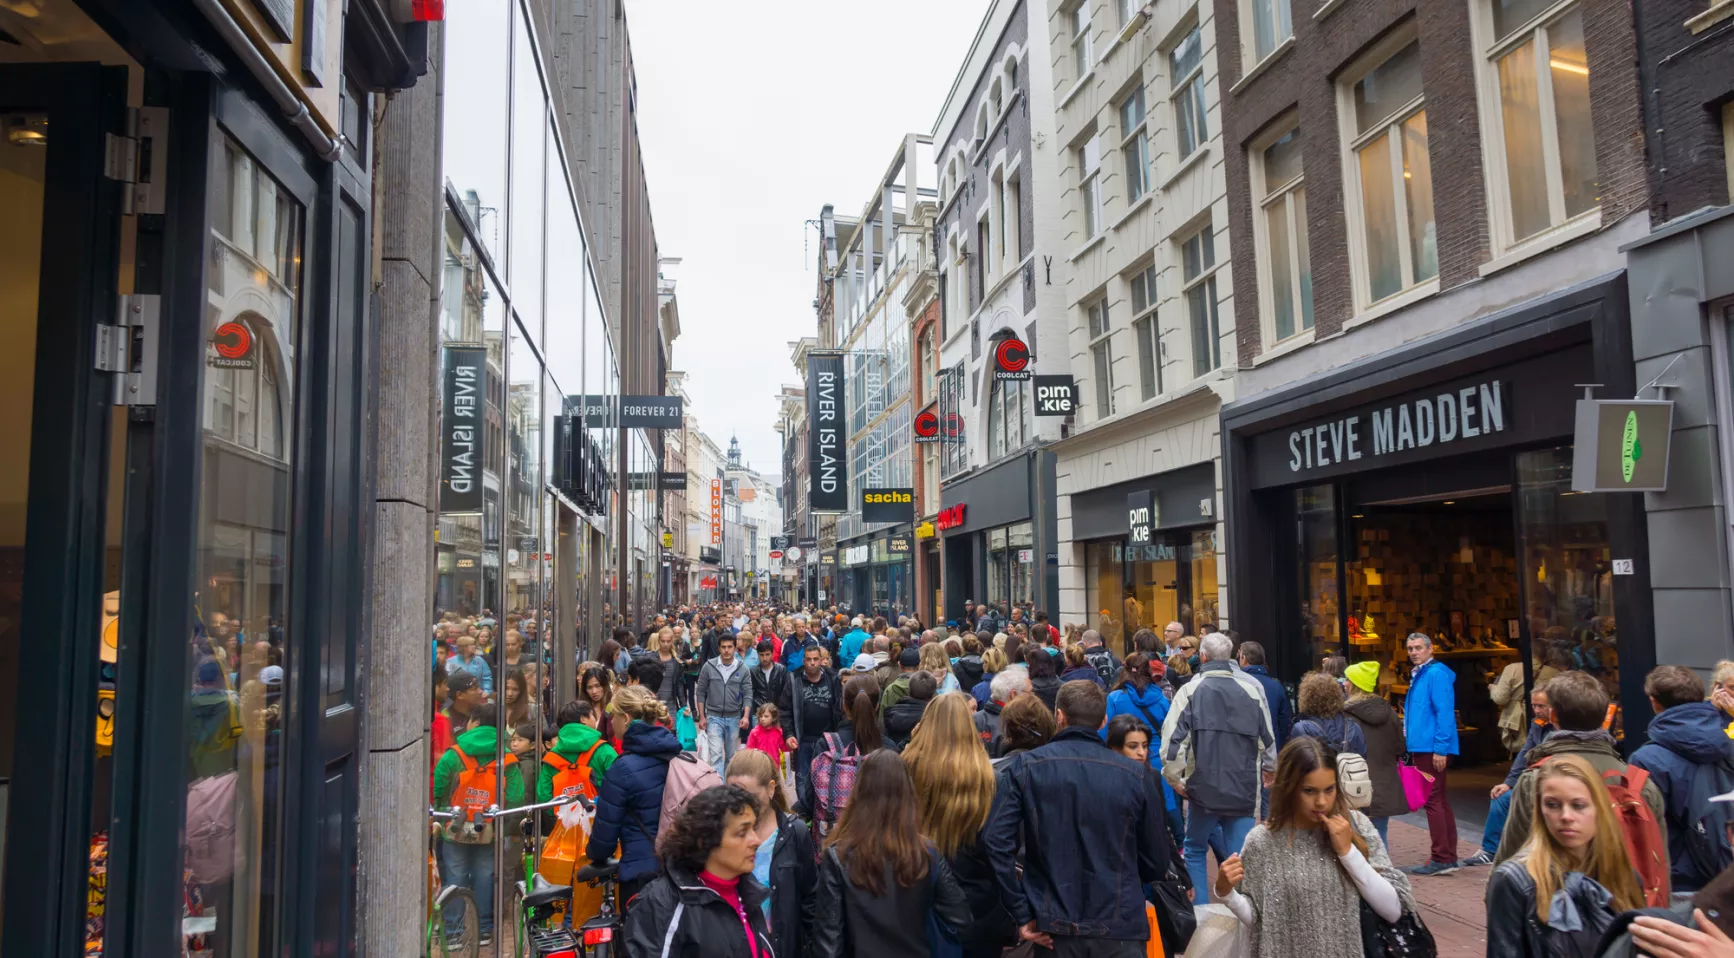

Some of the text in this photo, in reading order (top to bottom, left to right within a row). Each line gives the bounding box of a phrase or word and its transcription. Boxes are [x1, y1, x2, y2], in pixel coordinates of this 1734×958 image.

[624, 406, 679, 416] FOREVER 21
[1289, 380, 1504, 472] STEVE MADDEN
[818, 372, 837, 493] RIVER ISLAND
[864, 491, 912, 503] sacha
[1616, 561, 1630, 573] 12
